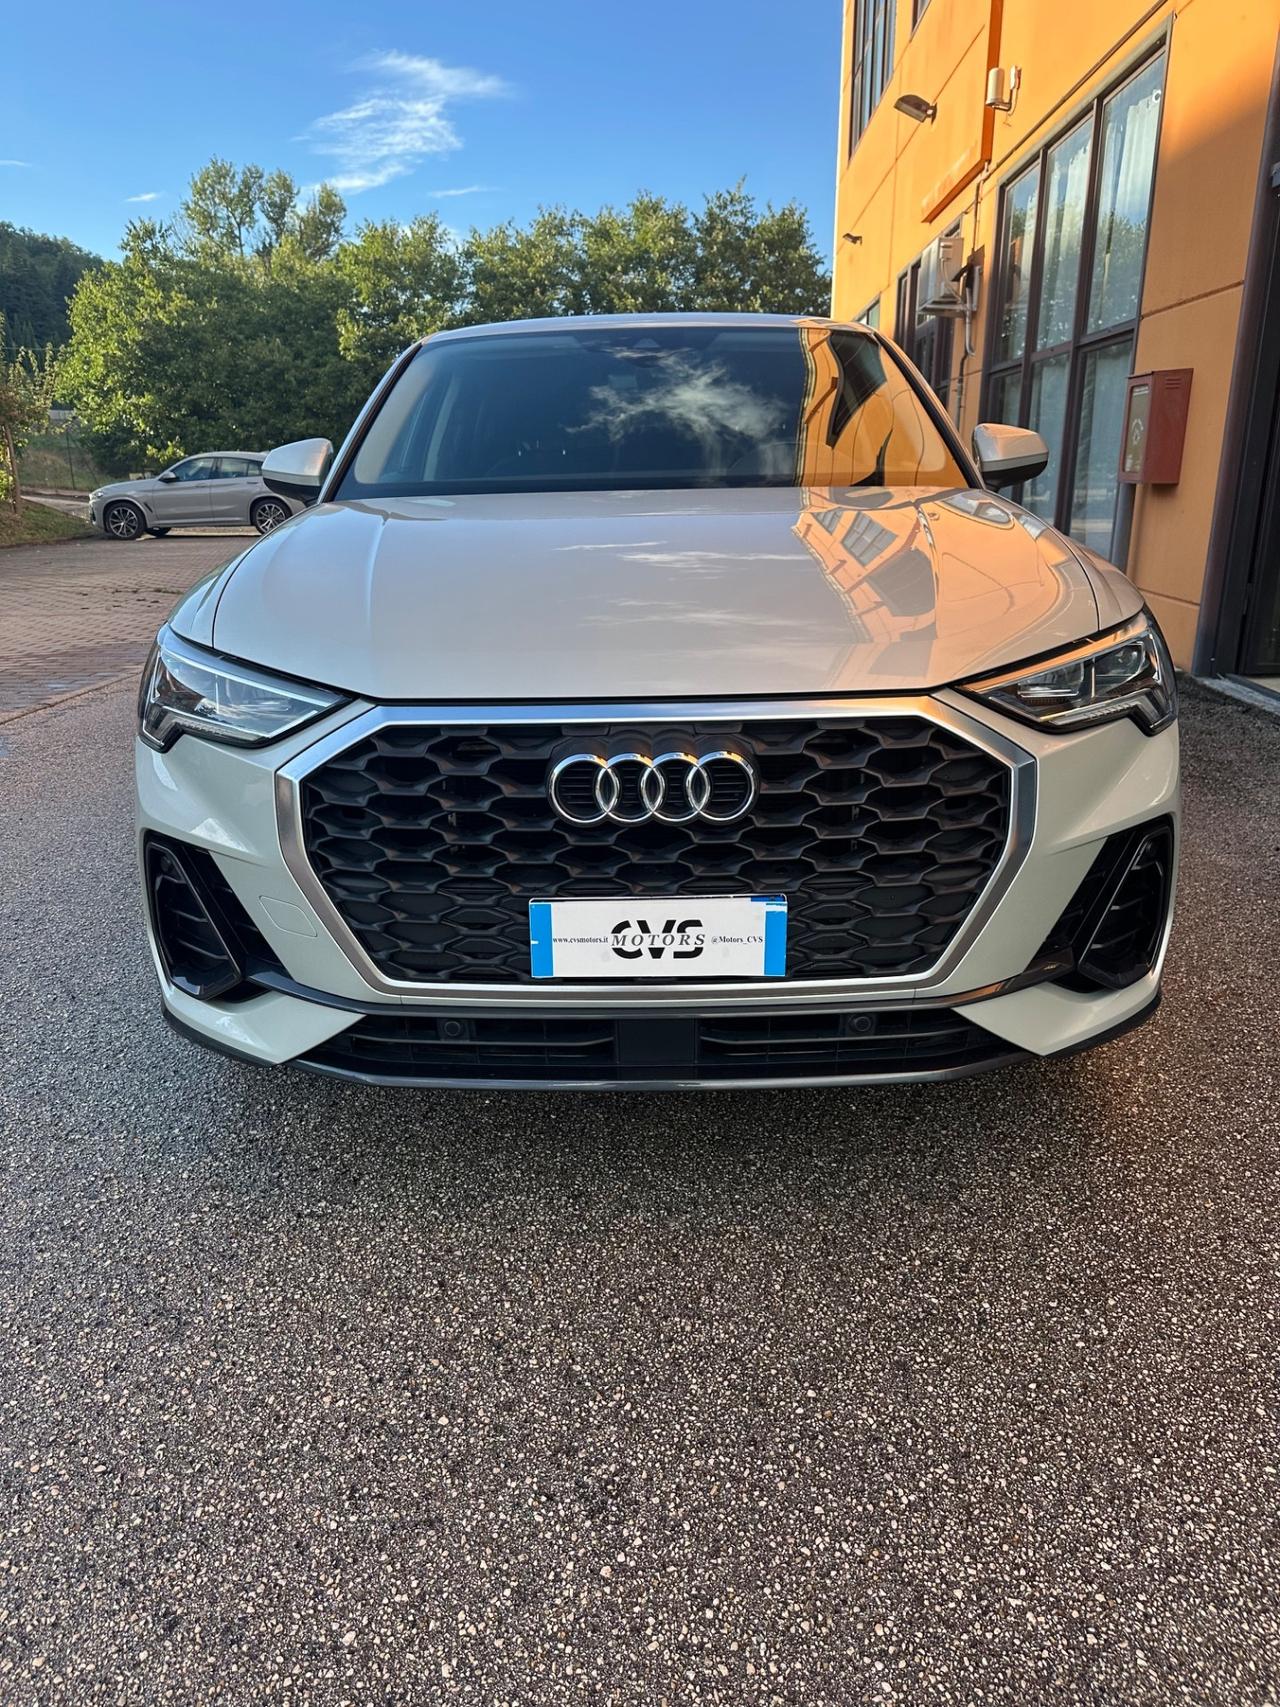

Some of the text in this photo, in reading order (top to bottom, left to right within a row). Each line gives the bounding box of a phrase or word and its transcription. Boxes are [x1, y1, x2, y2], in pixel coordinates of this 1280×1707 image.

[552, 935, 609, 943] www.cvsmotors.it
[611, 919, 703, 959] CVS
[611, 934, 705, 947] MOTORS
[711, 935, 764, 944] @Motors_CVS
